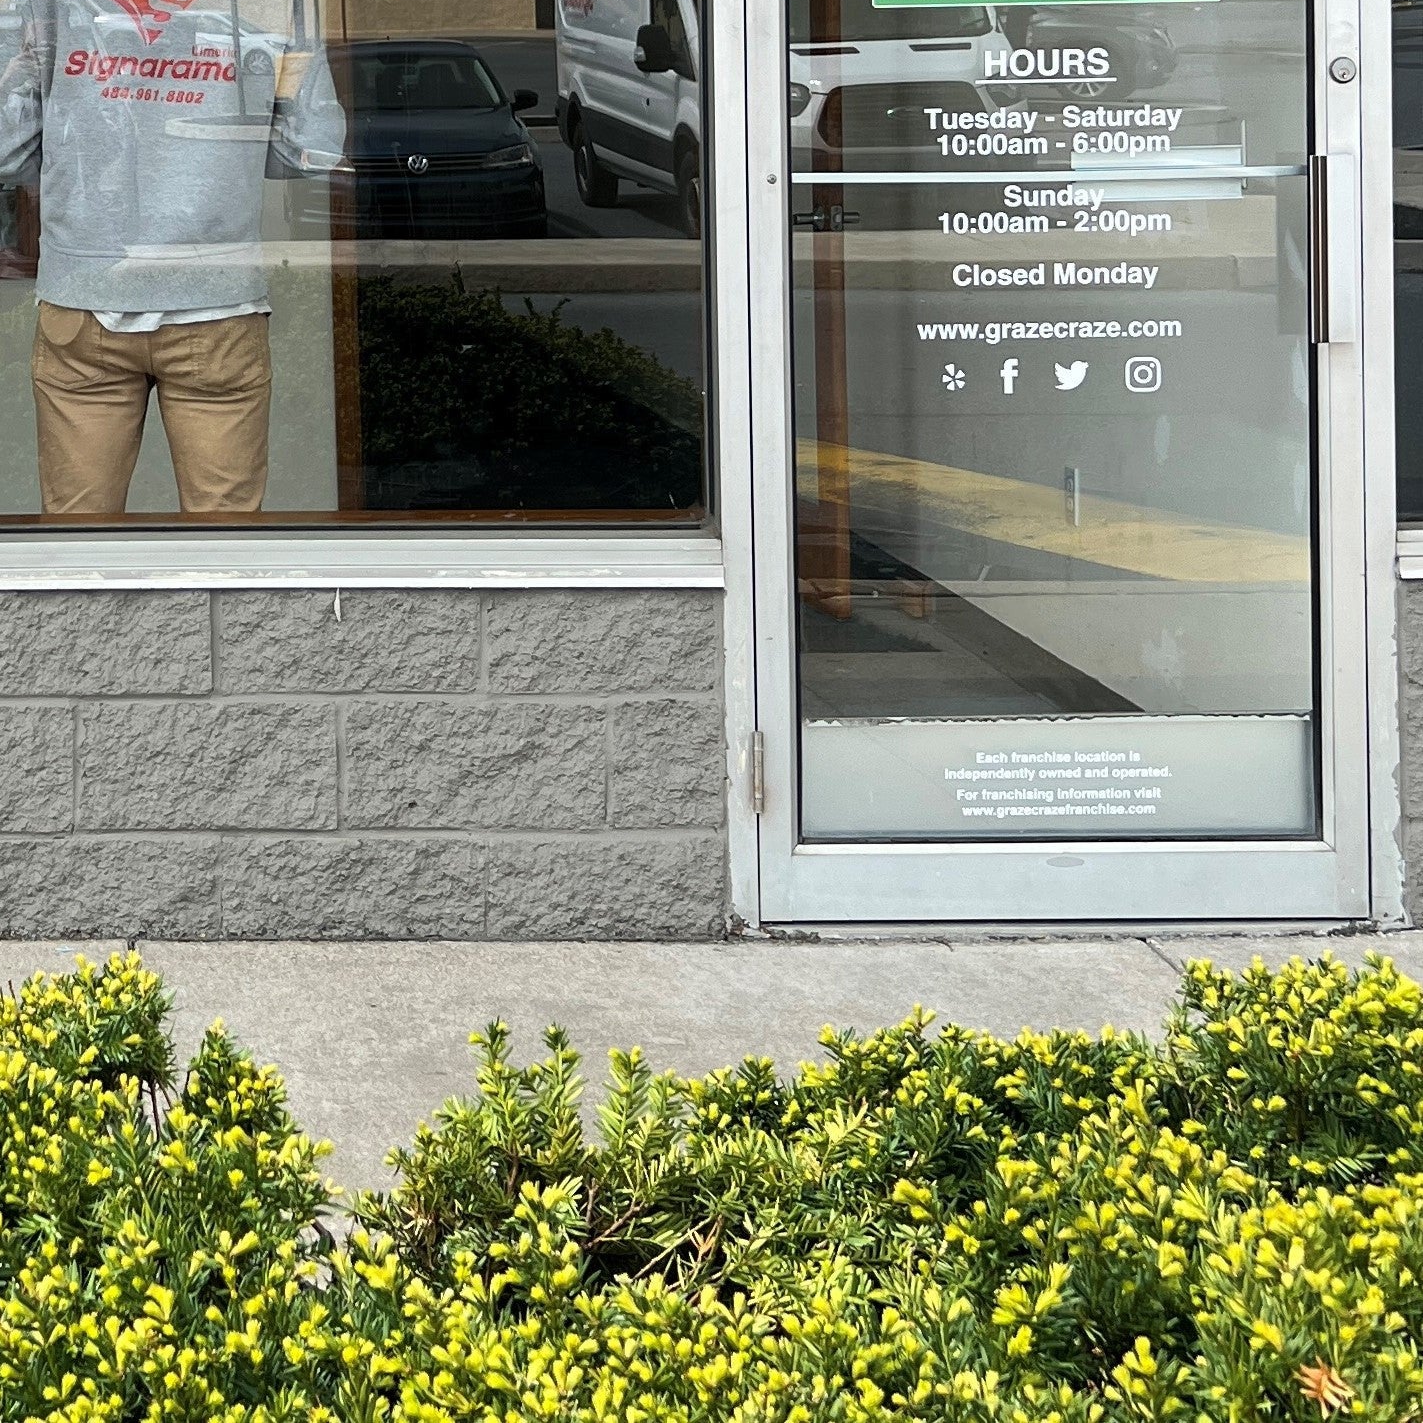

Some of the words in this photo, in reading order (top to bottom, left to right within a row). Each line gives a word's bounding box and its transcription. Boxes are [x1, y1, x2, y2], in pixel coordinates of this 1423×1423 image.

[64, 50, 237, 82] Signarama
[983, 48, 1111, 77] HOURS
[923, 107, 1038, 133] Tuesday
[1062, 105, 1183, 131] Saturday
[936, 134, 1048, 156] 10:00am
[1072, 132, 1171, 158] 6:00pm
[1003, 184, 1105, 211] Sunday
[938, 212, 1049, 234] 10:00am
[1073, 210, 1172, 237] 2:00pm
[952, 263, 1044, 286] Closed
[1053, 262, 1159, 289] Monday
[917, 320, 1182, 344] www.grazecraze.com
[976, 751, 1008, 764] Each
[1011, 751, 1071, 763] franchise
[1075, 751, 1126, 763] location
[1129, 751, 1141, 762] is
[1038, 767, 1083, 778] owned
[1084, 766, 1108, 778] and
[1111, 766, 1173, 780] operated.
[956, 788, 978, 801] For
[981, 788, 1054, 802] franchising
[1057, 787, 1131, 800] information
[1134, 787, 1162, 799] visit
[962, 803, 1157, 818] www.grazecrazefranchise.com
